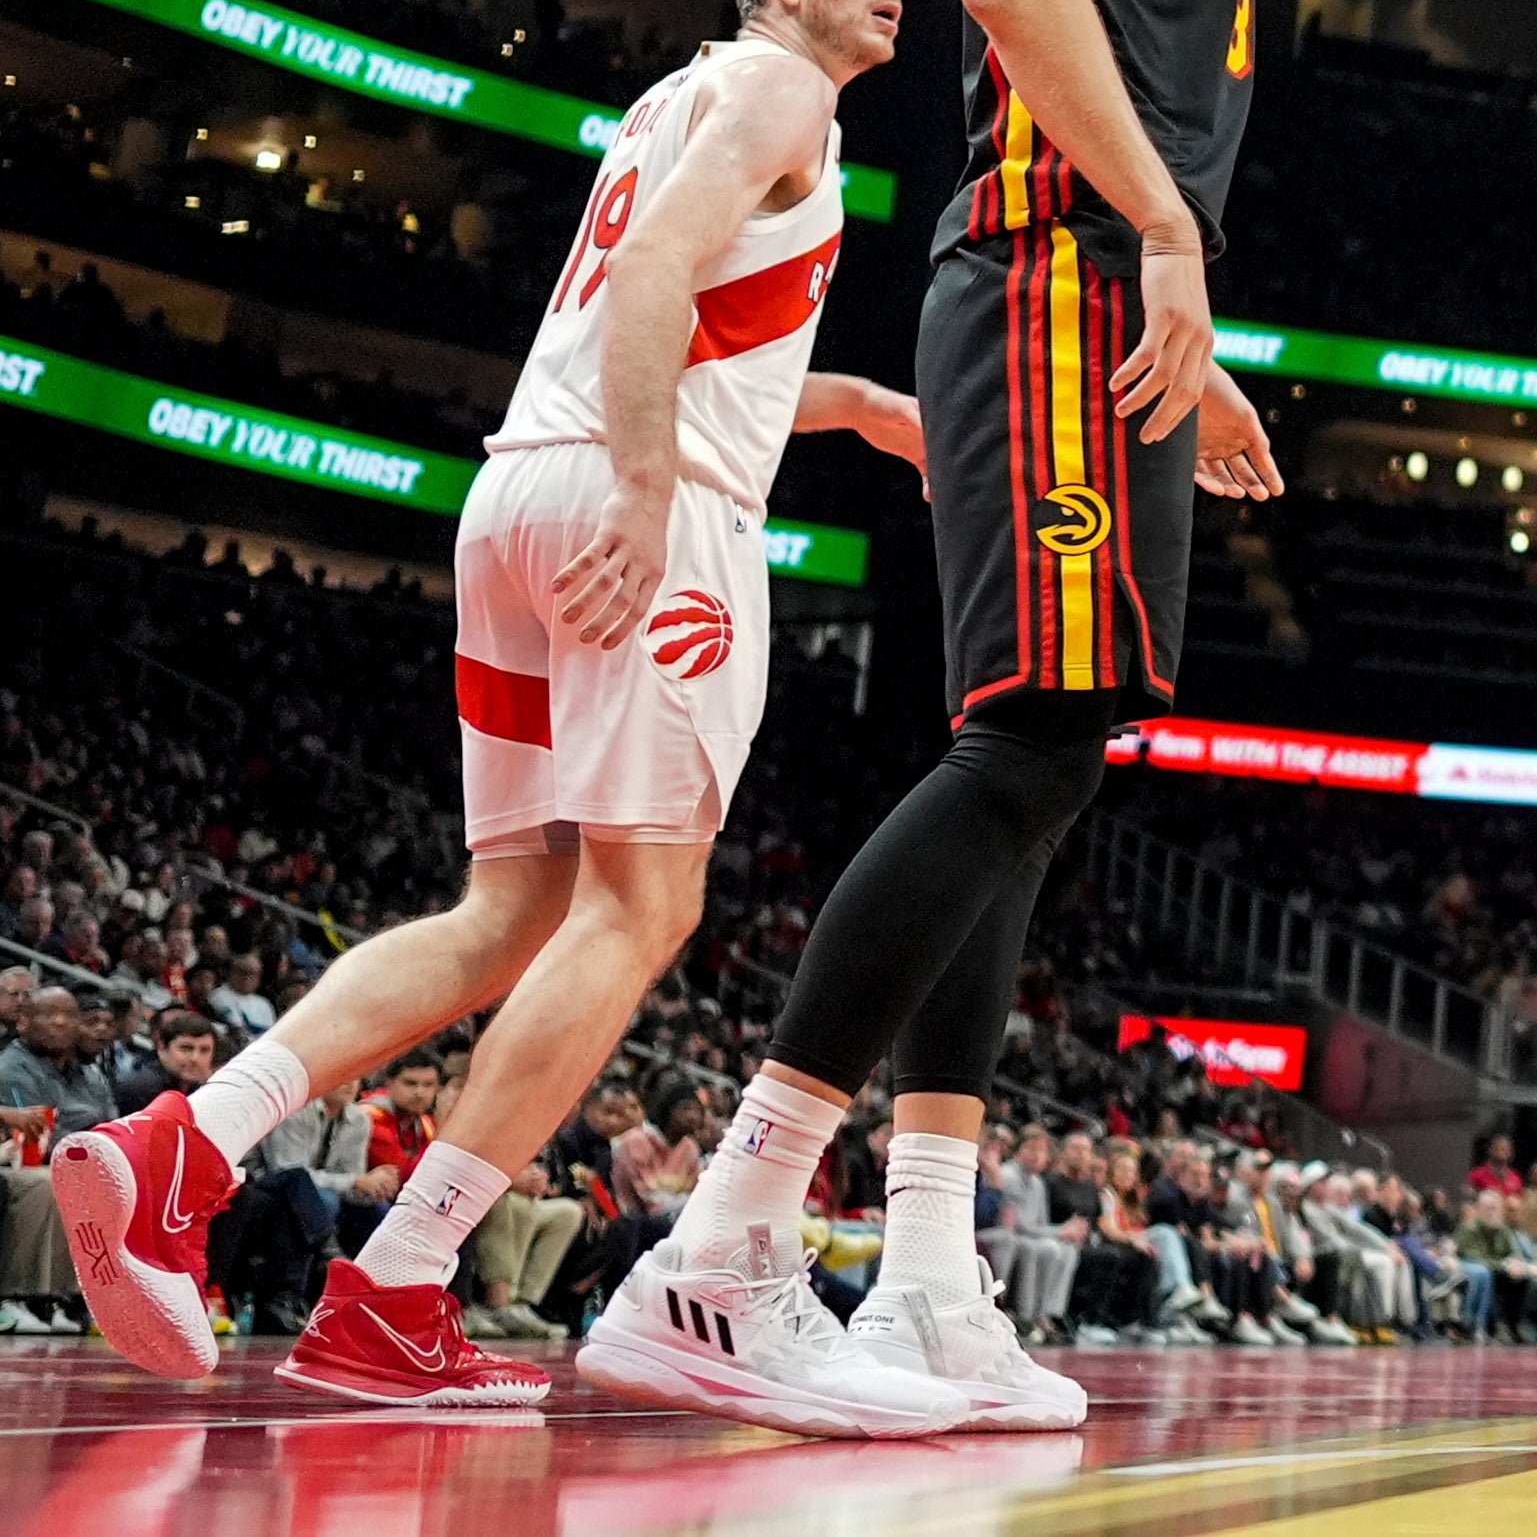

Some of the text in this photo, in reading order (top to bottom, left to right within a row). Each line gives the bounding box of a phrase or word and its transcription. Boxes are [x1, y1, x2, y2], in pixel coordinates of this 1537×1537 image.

[280, 18, 366, 79] YOUR
[363, 54, 476, 110] THIRST
[552, 165, 639, 313] 19
[148, 397, 425, 494] OBEY YOUR THIRST
